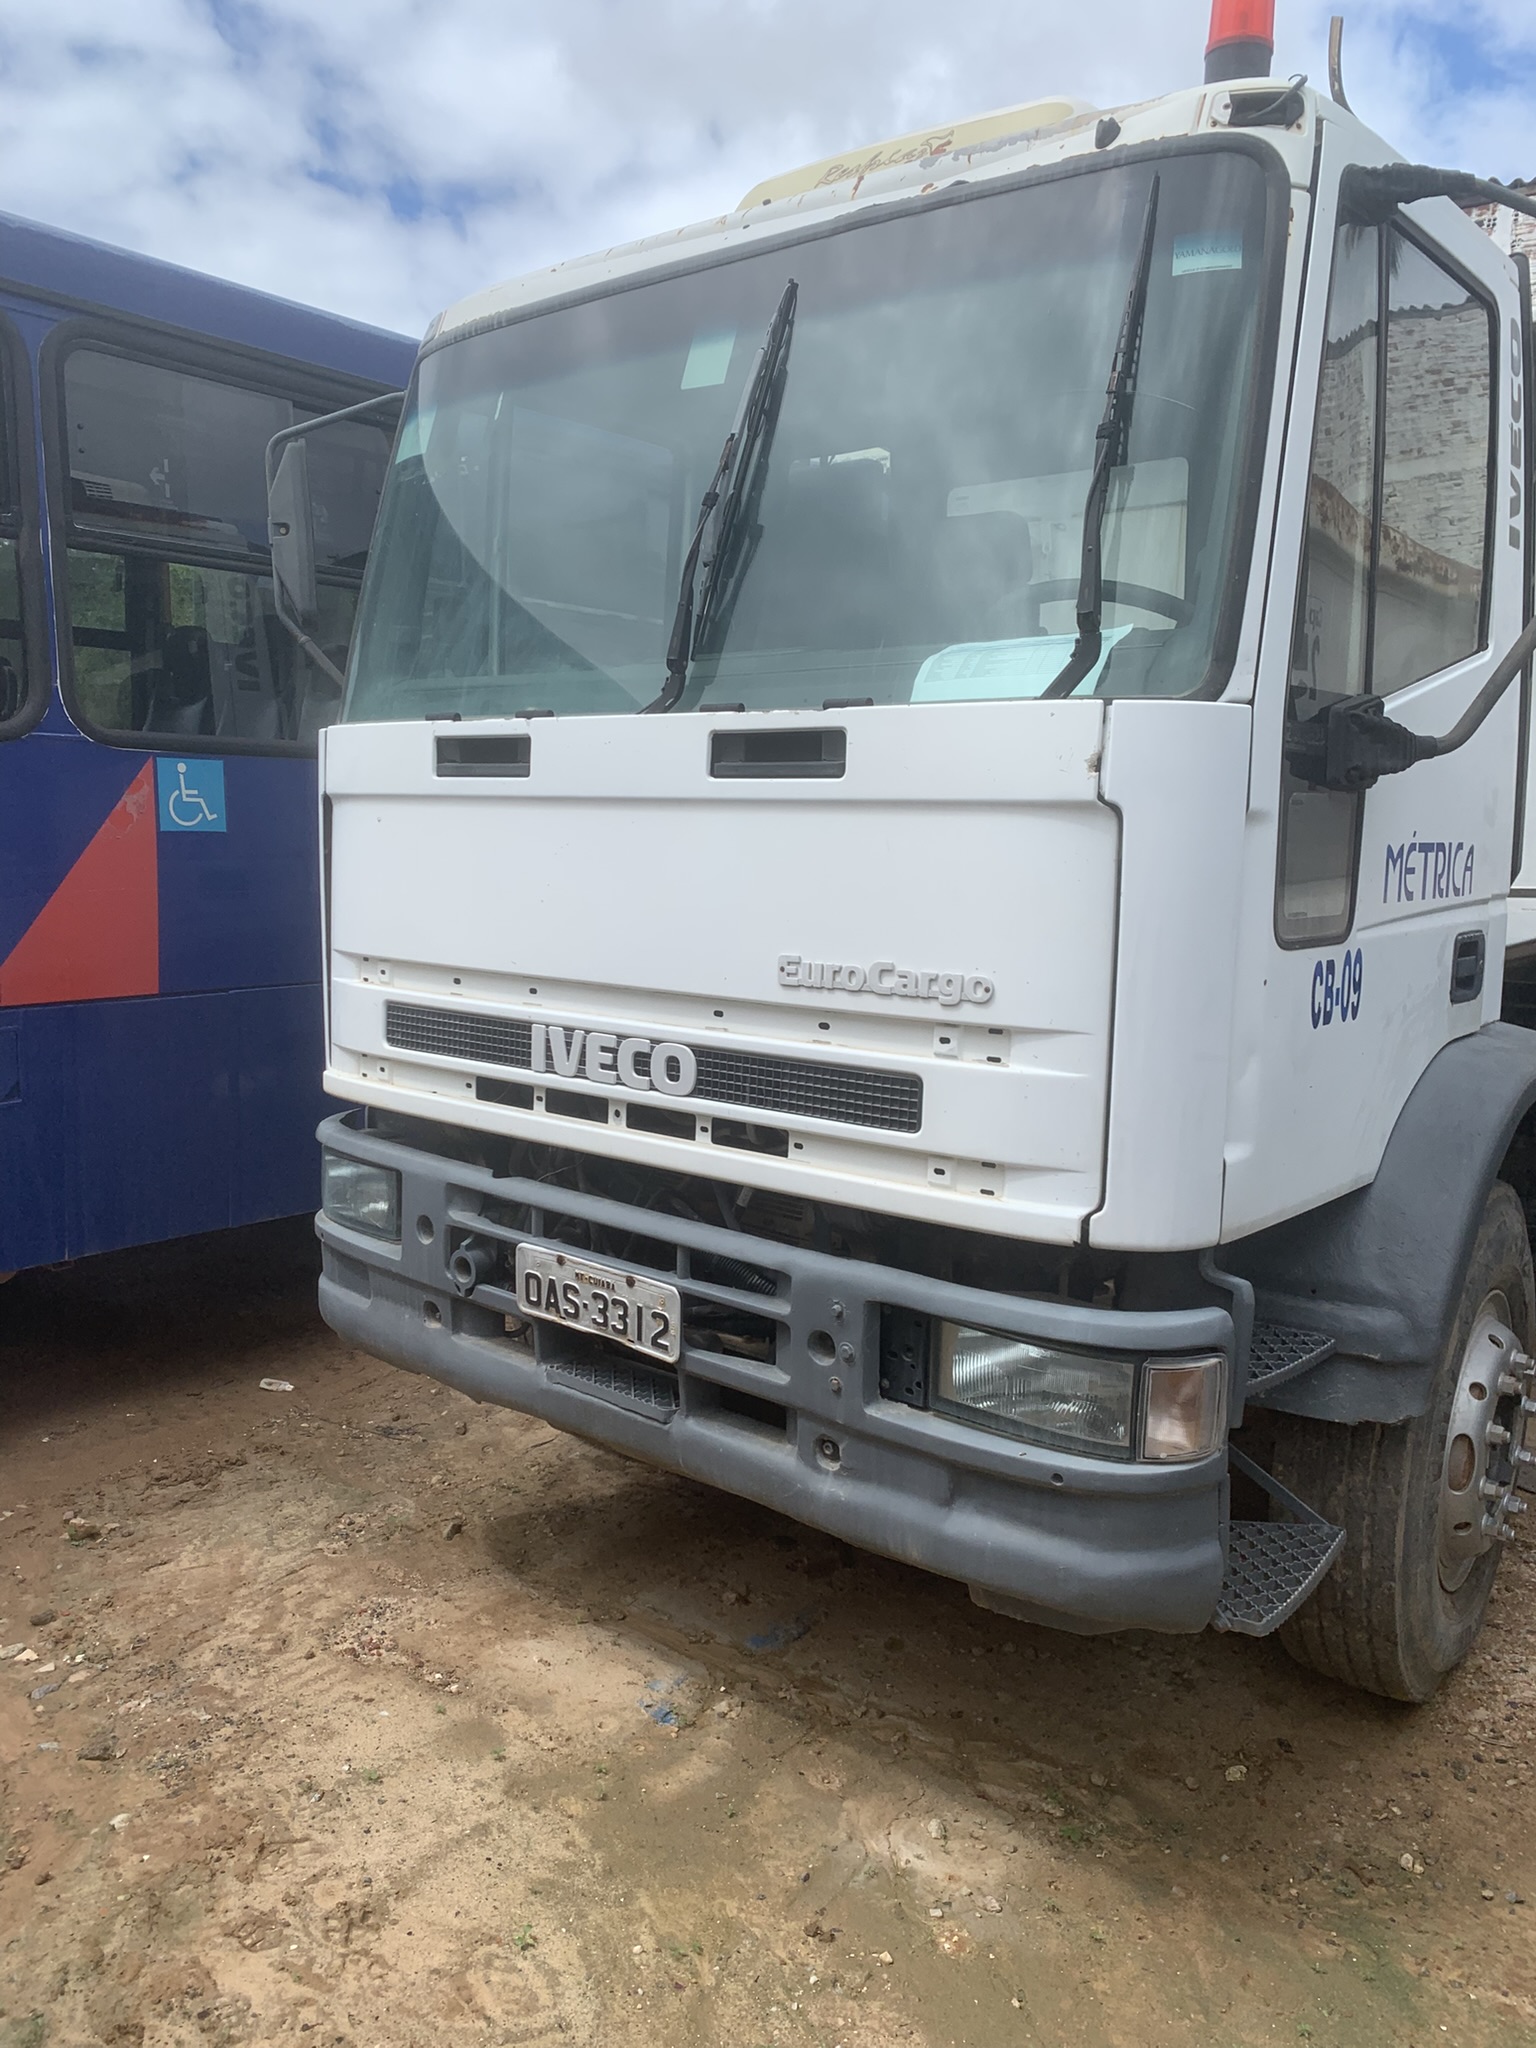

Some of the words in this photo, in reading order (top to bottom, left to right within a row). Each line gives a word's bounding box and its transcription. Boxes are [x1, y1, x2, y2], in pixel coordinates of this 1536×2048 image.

[1508, 316, 1525, 551] IVECO
[1383, 830, 1475, 904] MÉTRICA
[778, 955, 995, 1006] EuroCargo
[1311, 947, 1363, 1030] CB-09
[530, 1023, 697, 1097] IVECO
[524, 1269, 671, 1353] OAS-3312
